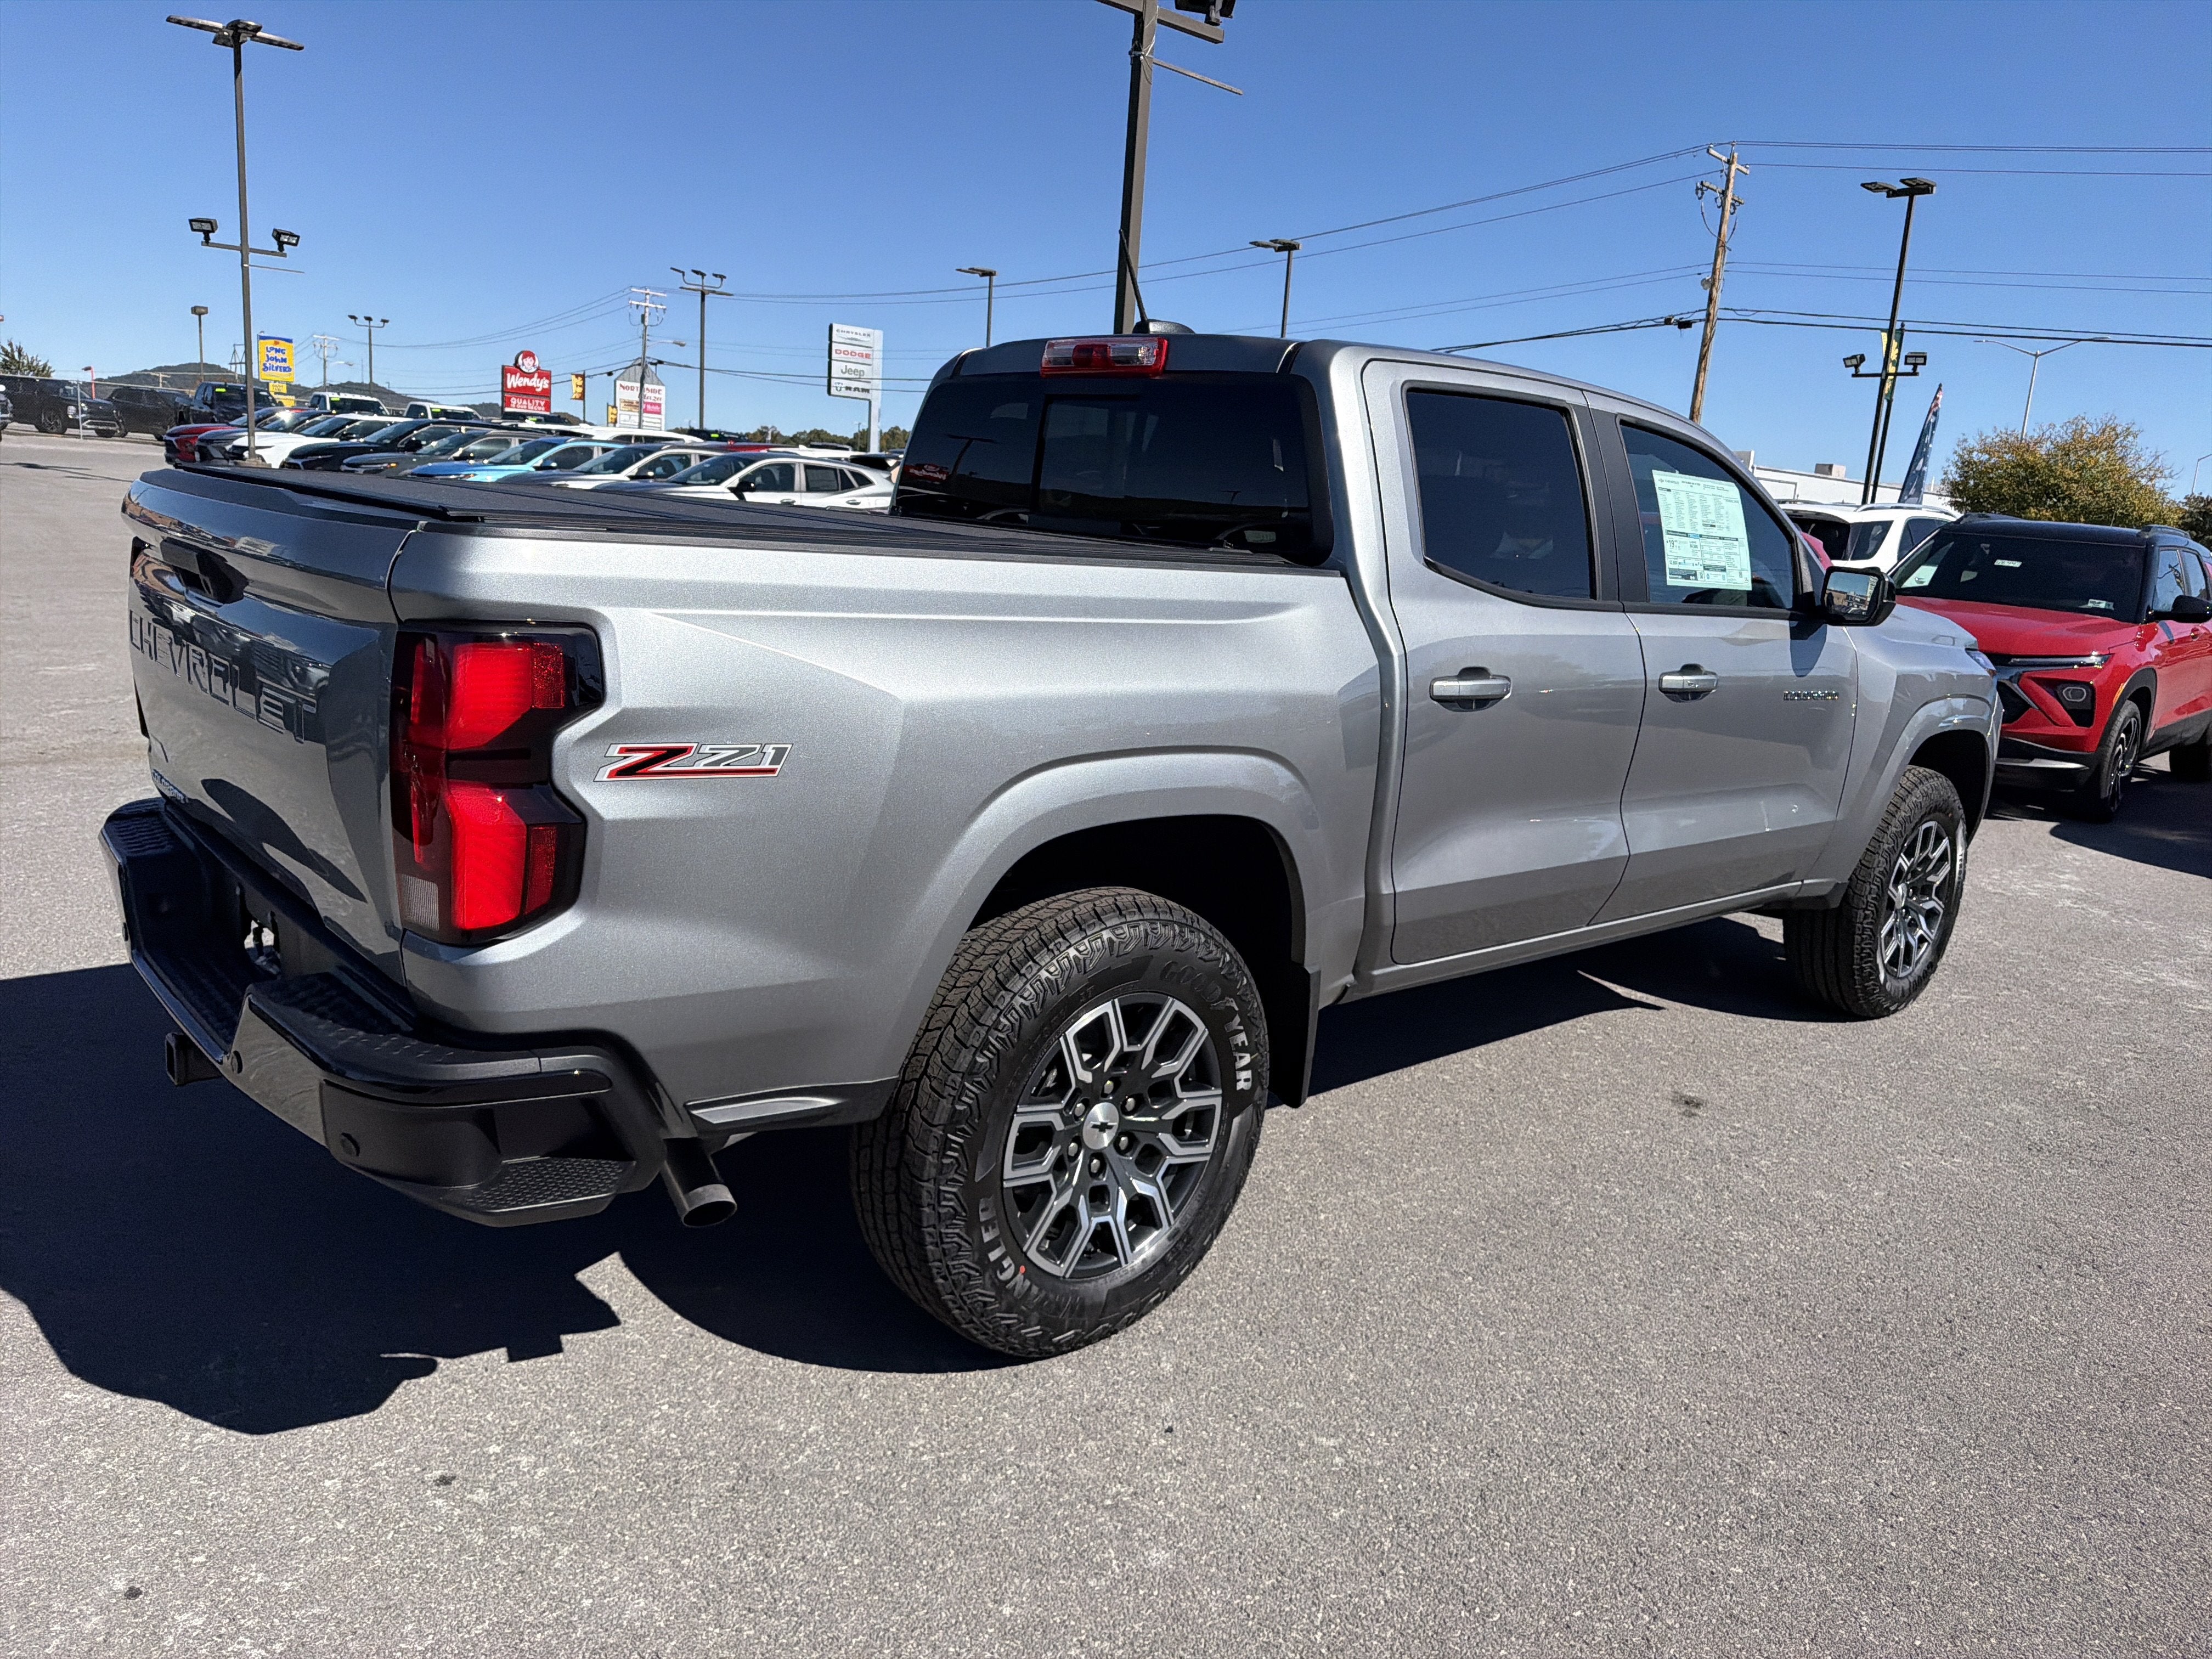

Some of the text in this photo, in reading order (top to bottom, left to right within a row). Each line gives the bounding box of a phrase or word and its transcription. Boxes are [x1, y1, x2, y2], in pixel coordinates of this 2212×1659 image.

[836, 329, 871, 337] CHRYSLER
[834, 349, 871, 359] DODGE
[840, 365, 865, 377] Jeep
[506, 373, 549, 392] Wendy's
[619, 383, 662, 395] NORTSIDE
[845, 386, 870, 394] RAM
[510, 397, 545, 407] QUALITY
[129, 609, 317, 744] CHEVROLET
[593, 742, 794, 782] Z71
[1160, 960, 1252, 1091] GOODYEAR
